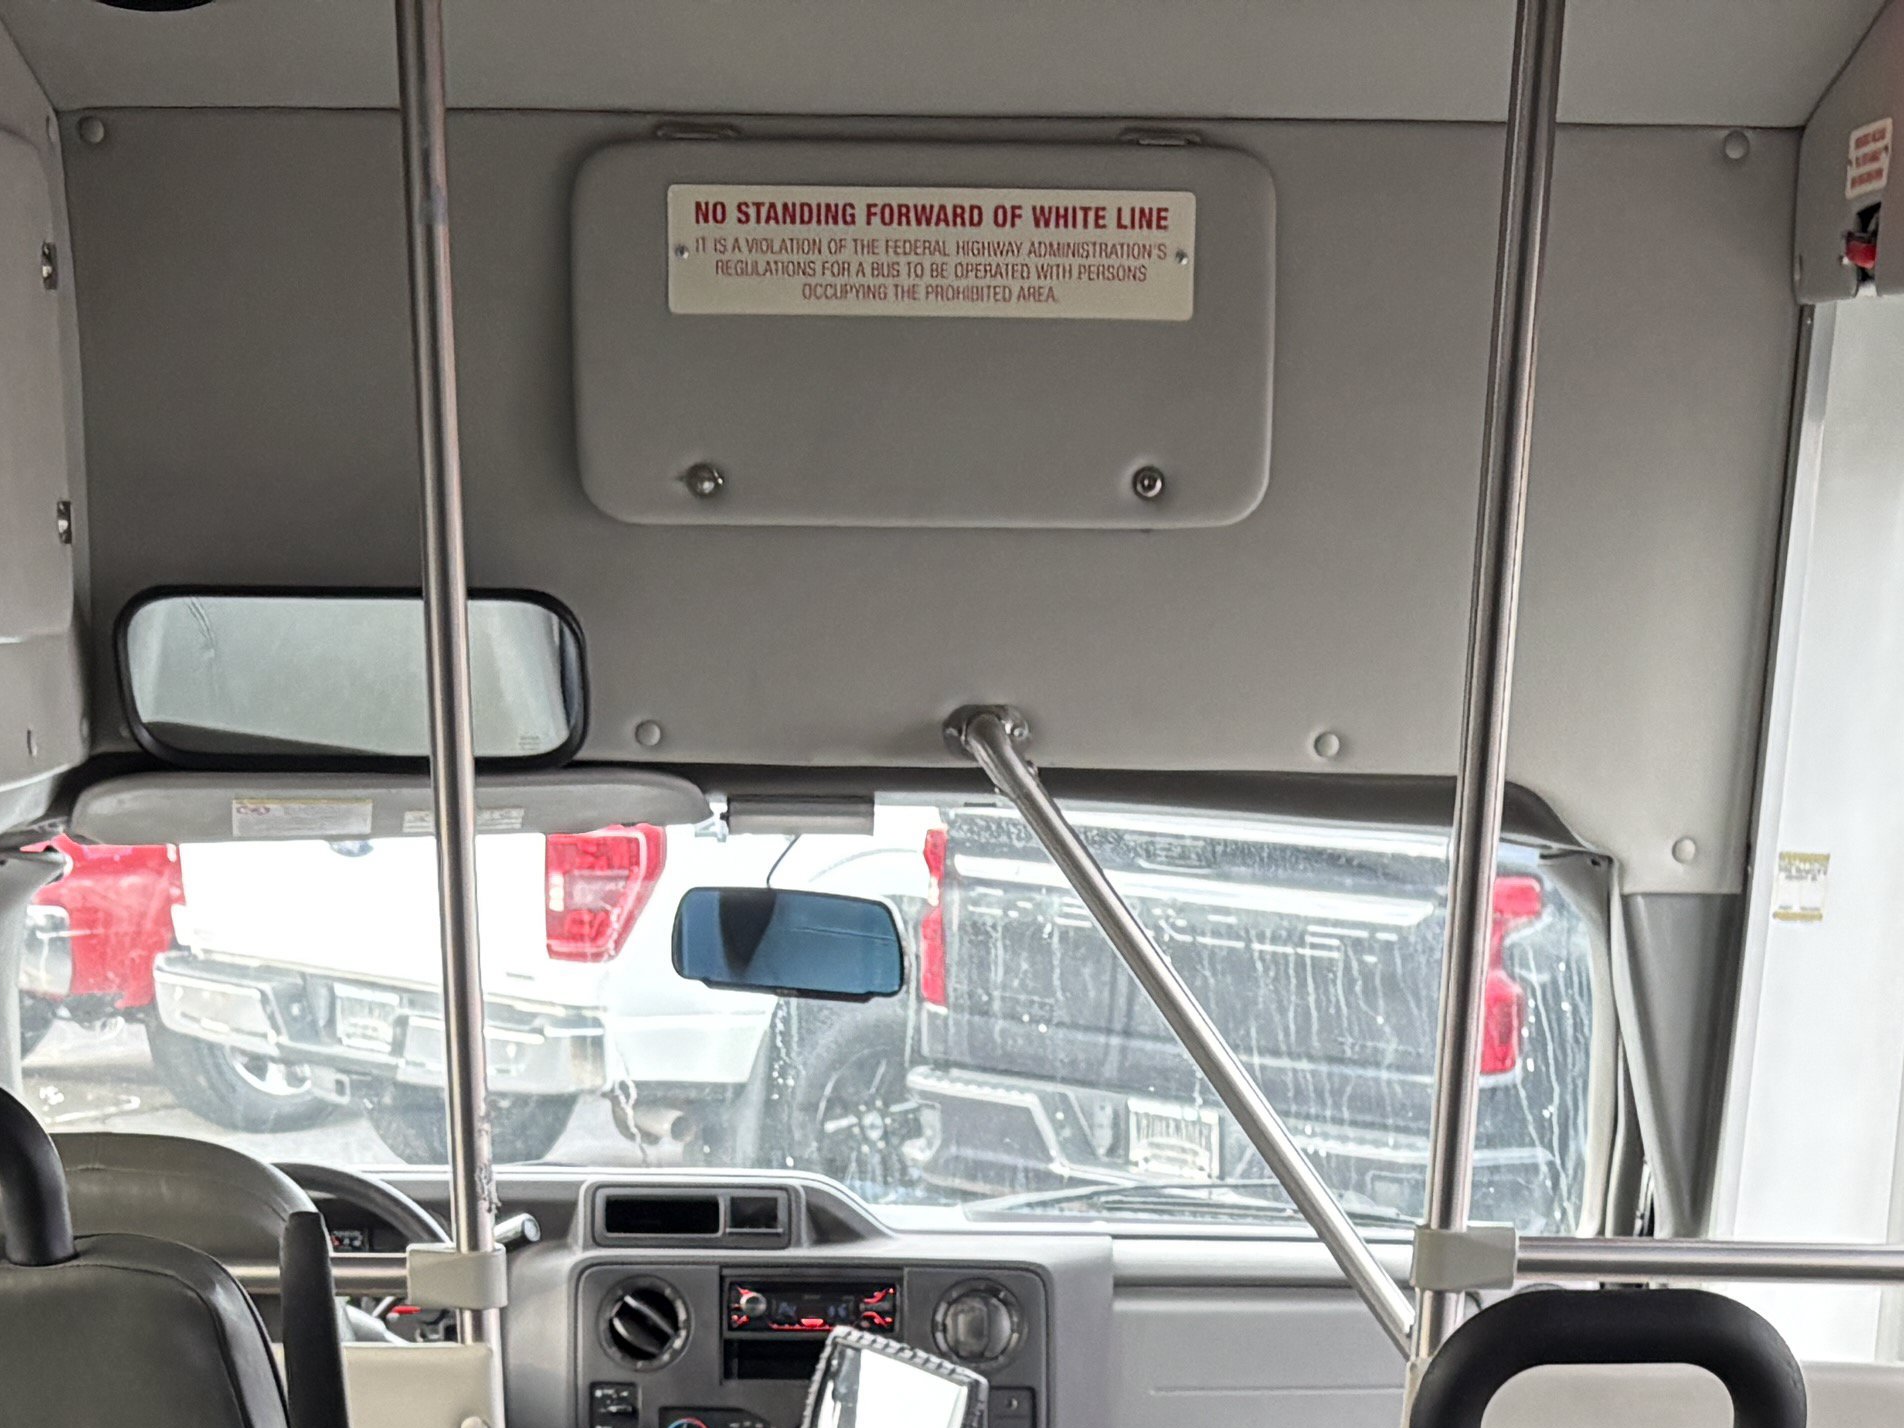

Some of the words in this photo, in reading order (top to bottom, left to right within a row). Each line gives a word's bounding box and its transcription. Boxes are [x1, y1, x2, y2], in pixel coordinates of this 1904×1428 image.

[695, 201, 727, 225] NO
[736, 202, 856, 226] STANDING
[866, 203, 984, 228] FORWARD
[993, 204, 1023, 228] OF
[1032, 205, 1107, 230] WHITE
[1117, 207, 1170, 231] LINE
[695, 236, 706, 253] IT
[714, 238, 727, 254] IS
[732, 238, 742, 254] A
[745, 238, 823, 256] VIOLATION
[828, 238, 847, 256] OF
[852, 239, 879, 256] THE
[885, 239, 949, 257] FEDERAL
[956, 240, 1023, 258] HIGHWAY
[1028, 241, 1167, 260] ADMINISTRATION'S
[715, 260, 816, 278] REGULATIONS
[821, 261, 850, 278] FOR
[855, 261, 866, 278] A
[871, 261, 900, 279] BUS
[907, 262, 925, 279] TO
[930, 262, 948, 279] BE
[954, 262, 1030, 280] OPERATED
[1036, 263, 1072, 281] WITH
[1078, 264, 1147, 282] PERSONS
[802, 283, 888, 300] OCCUPYING
[894, 284, 920, 301] THE
[925, 284, 1012, 303] PROHIBITED
